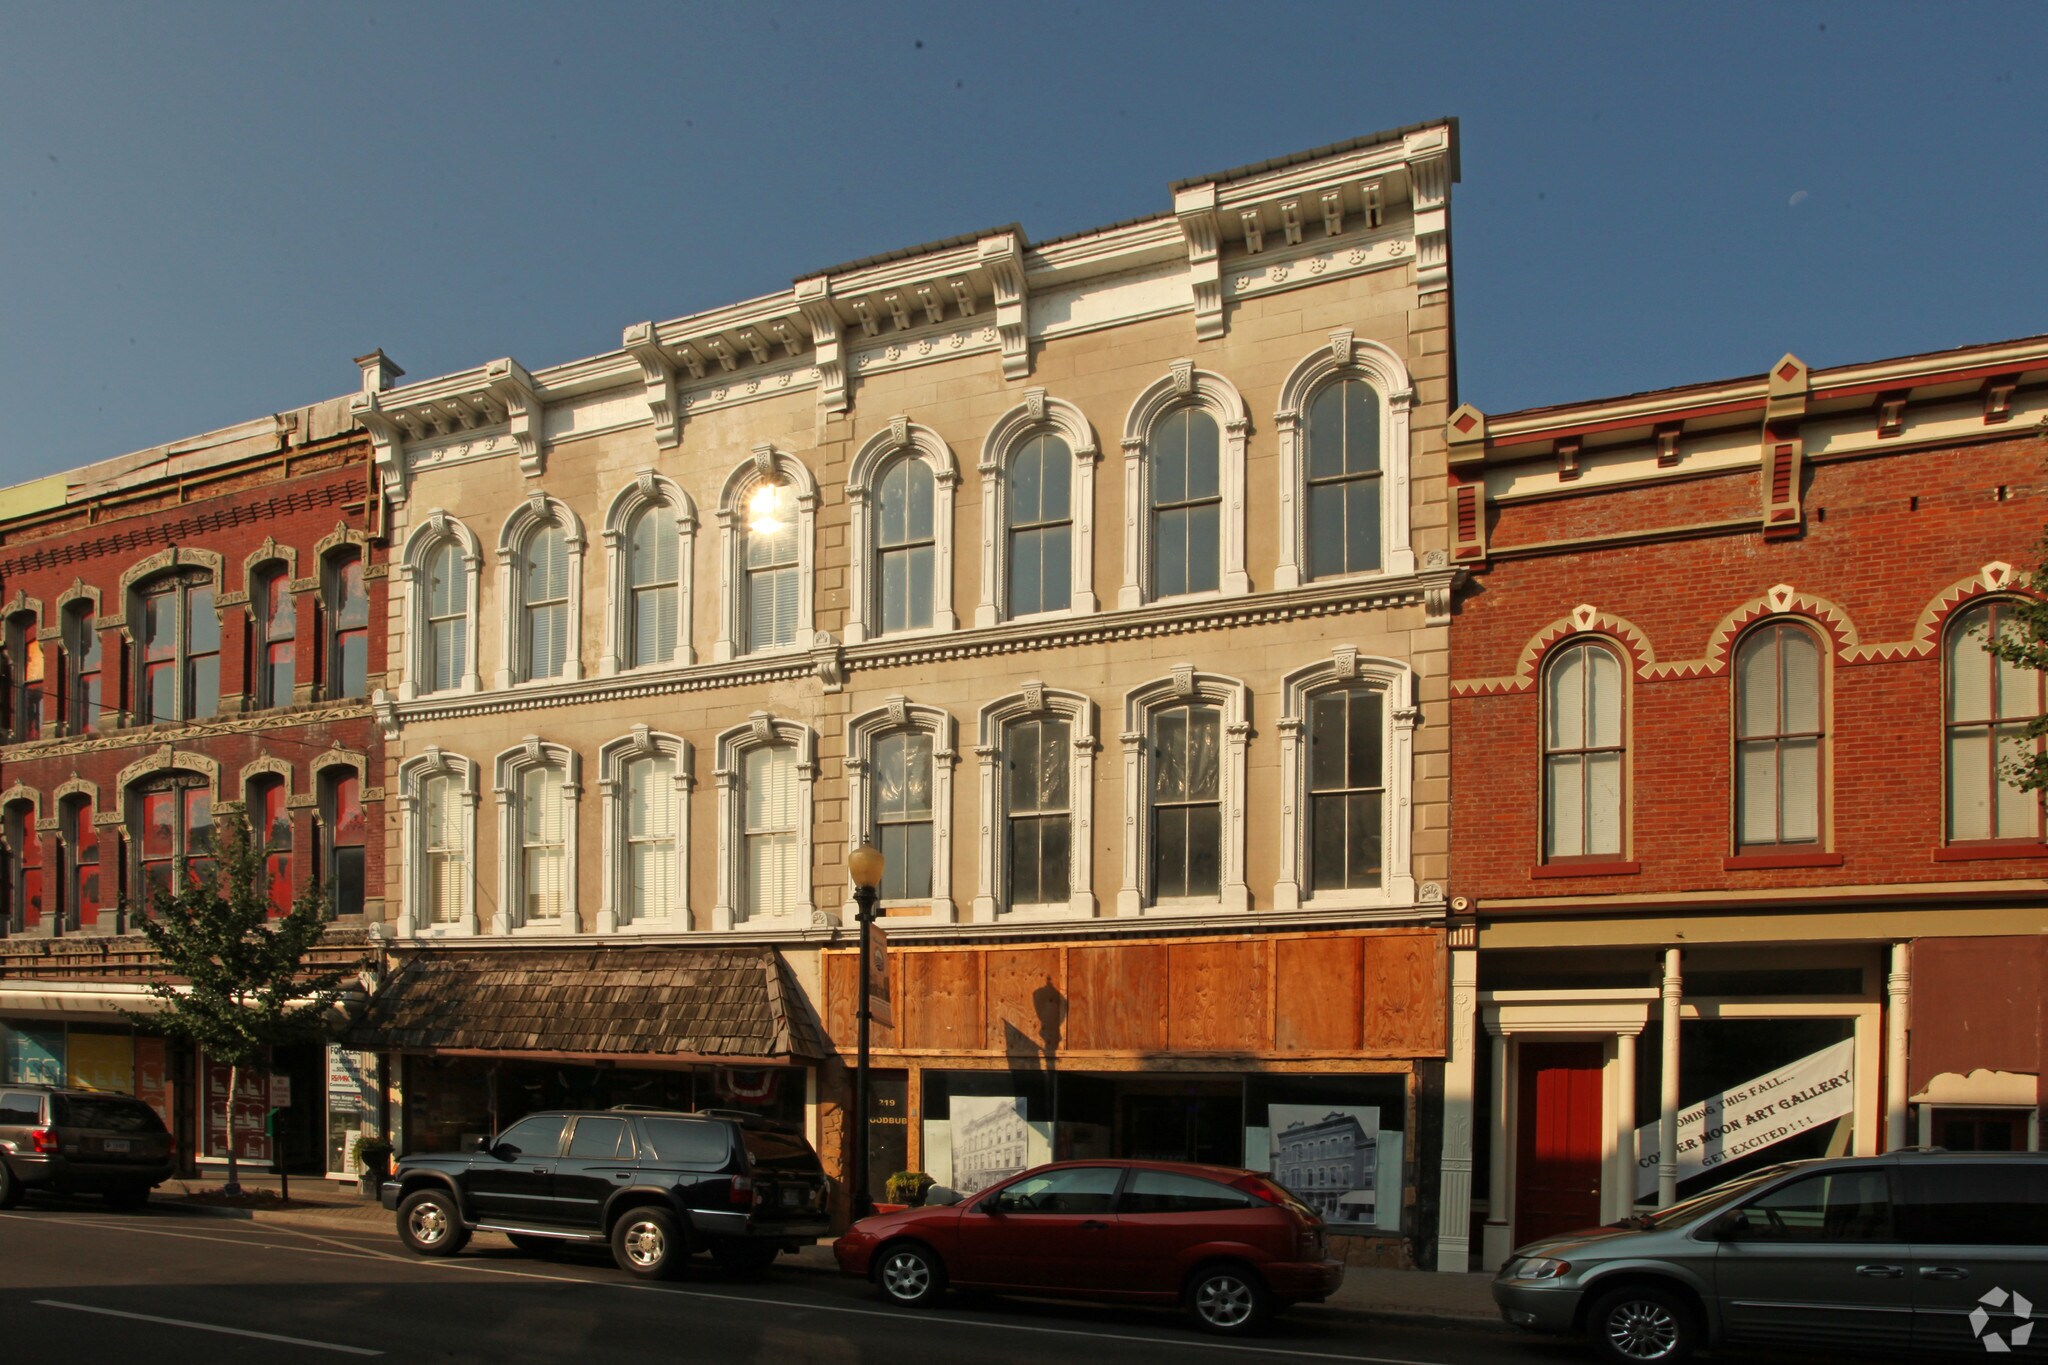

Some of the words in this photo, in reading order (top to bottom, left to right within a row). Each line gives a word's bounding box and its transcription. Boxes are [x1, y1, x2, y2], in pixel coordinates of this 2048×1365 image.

[1639, 1138, 1699, 1168] COER
[1698, 1119, 1742, 1144] MOON
[1745, 1105, 1777, 1126] ART
[1779, 1069, 1852, 1110] GALLERY
[1677, 1106, 1716, 1128] OMING
[1717, 1092, 1748, 1110] THIS
[1702, 1150, 1729, 1166] GET
